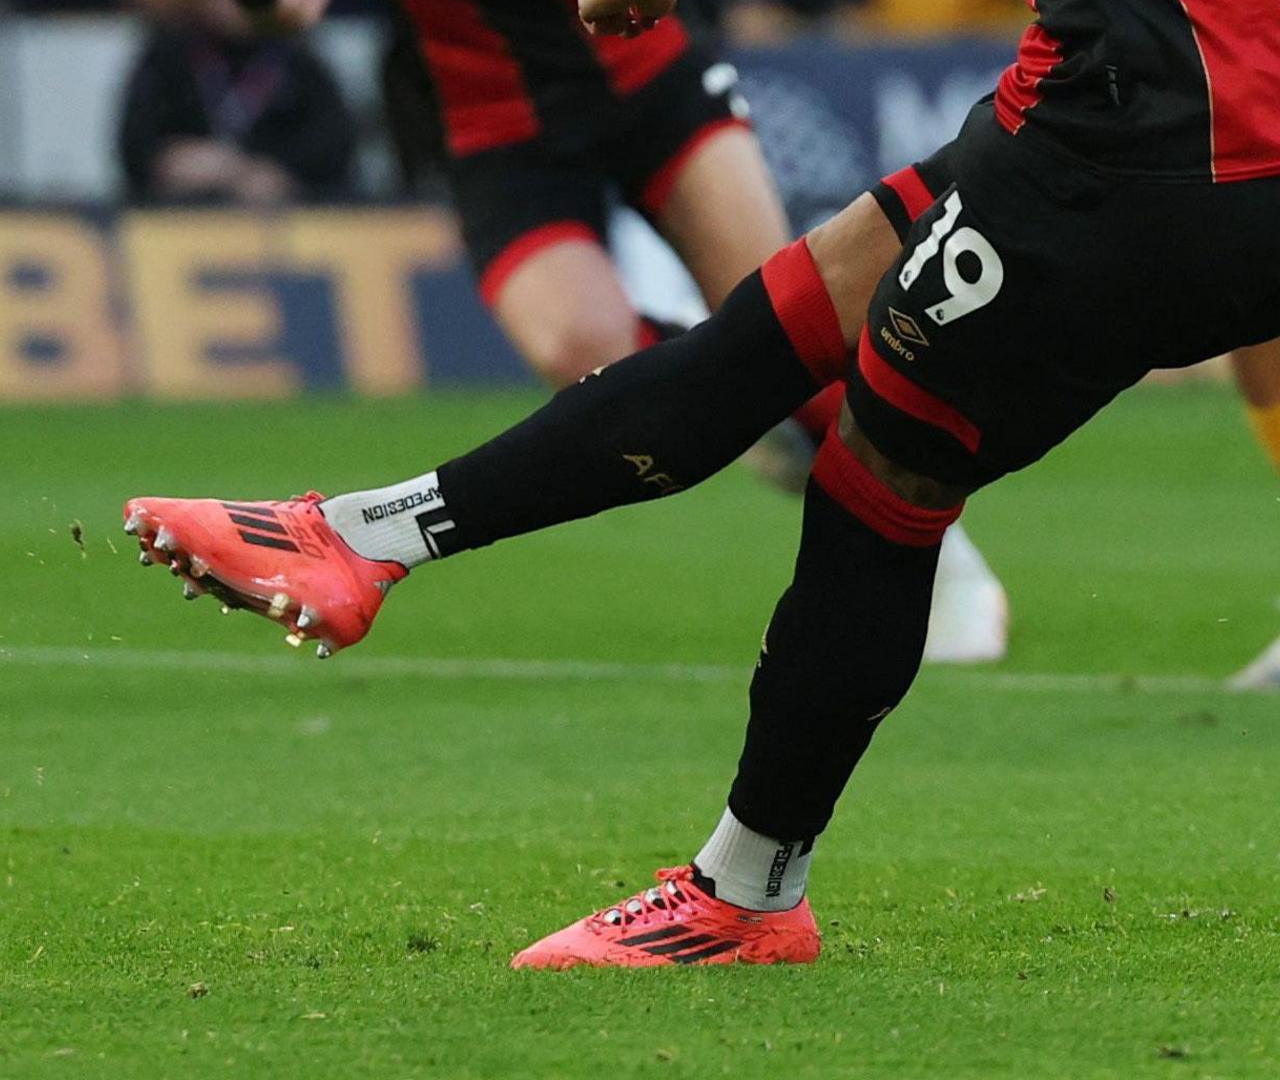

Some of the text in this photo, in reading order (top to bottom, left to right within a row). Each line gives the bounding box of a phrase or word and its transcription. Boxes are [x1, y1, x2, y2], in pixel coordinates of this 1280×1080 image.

[898, 189, 1005, 327] 19
[880, 327, 915, 361] umbro
[765, 840, 795, 897] PEDESIGN
